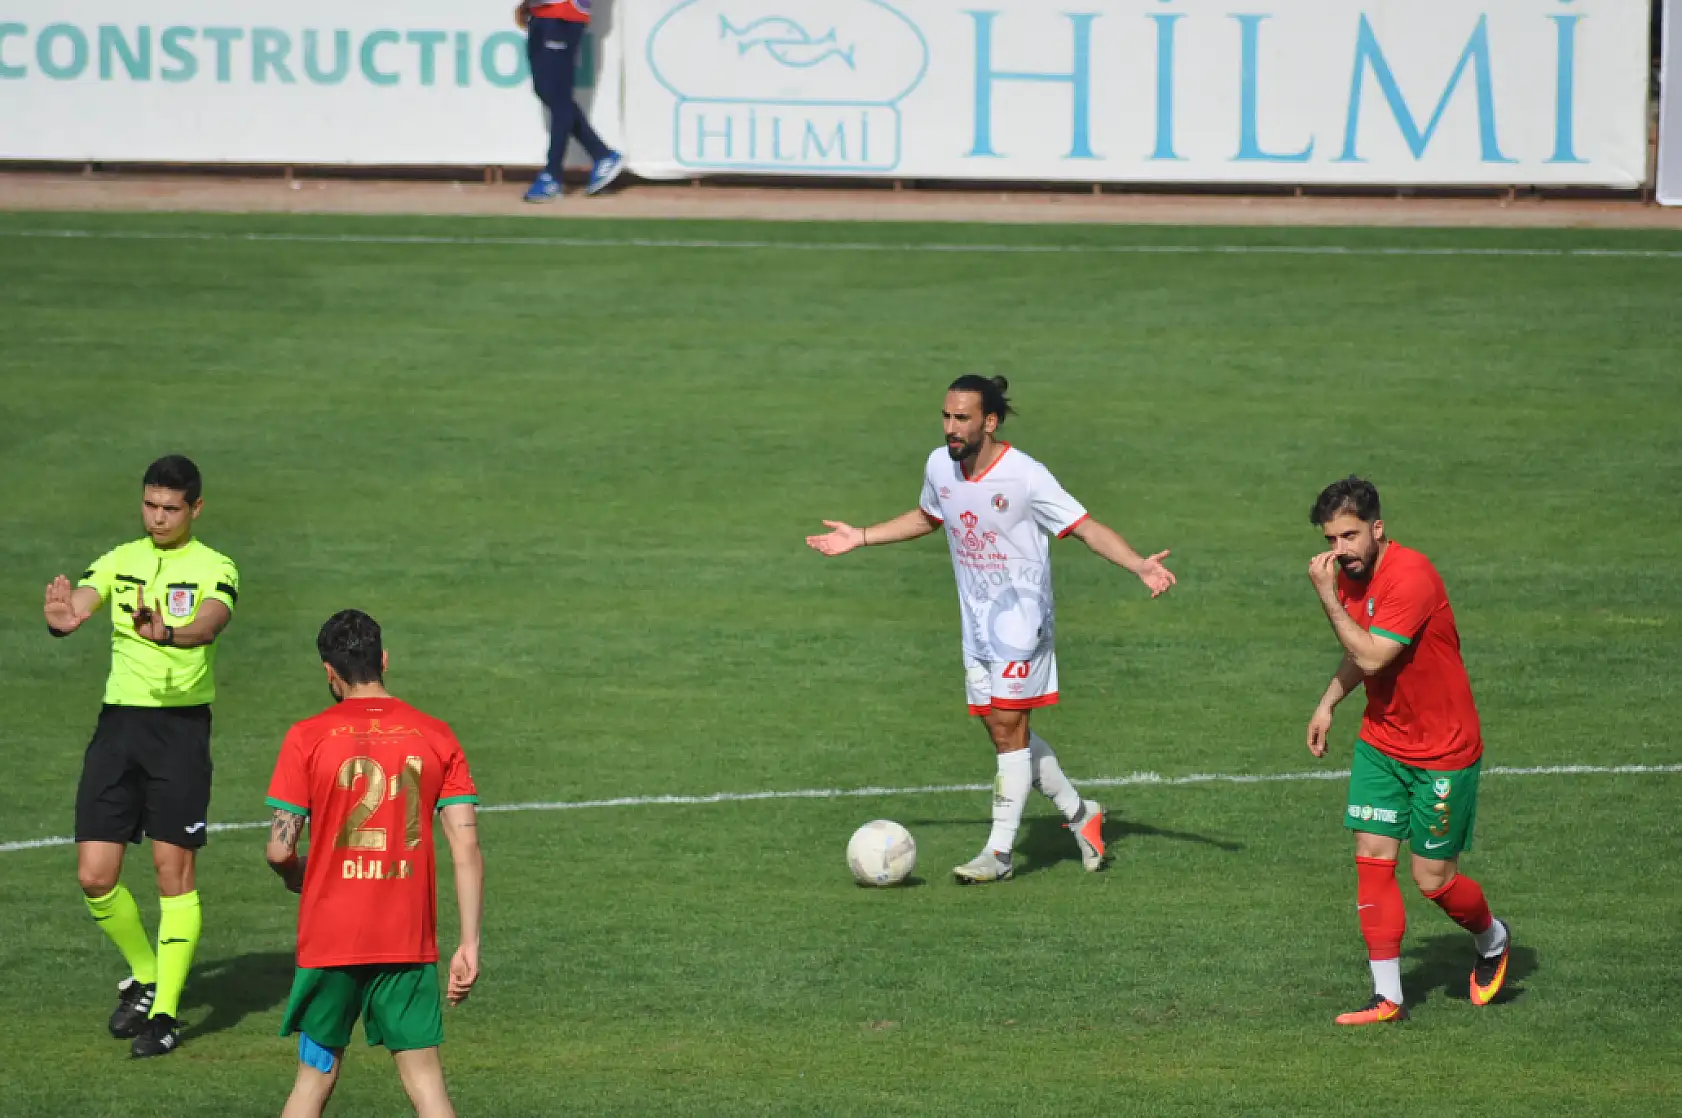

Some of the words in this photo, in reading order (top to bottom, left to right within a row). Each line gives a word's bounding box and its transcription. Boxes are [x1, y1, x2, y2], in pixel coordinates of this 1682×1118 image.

[962, 0, 1592, 163] HİLMİ
[696, 106, 867, 162] HİLMİ
[334, 756, 422, 851] 21
